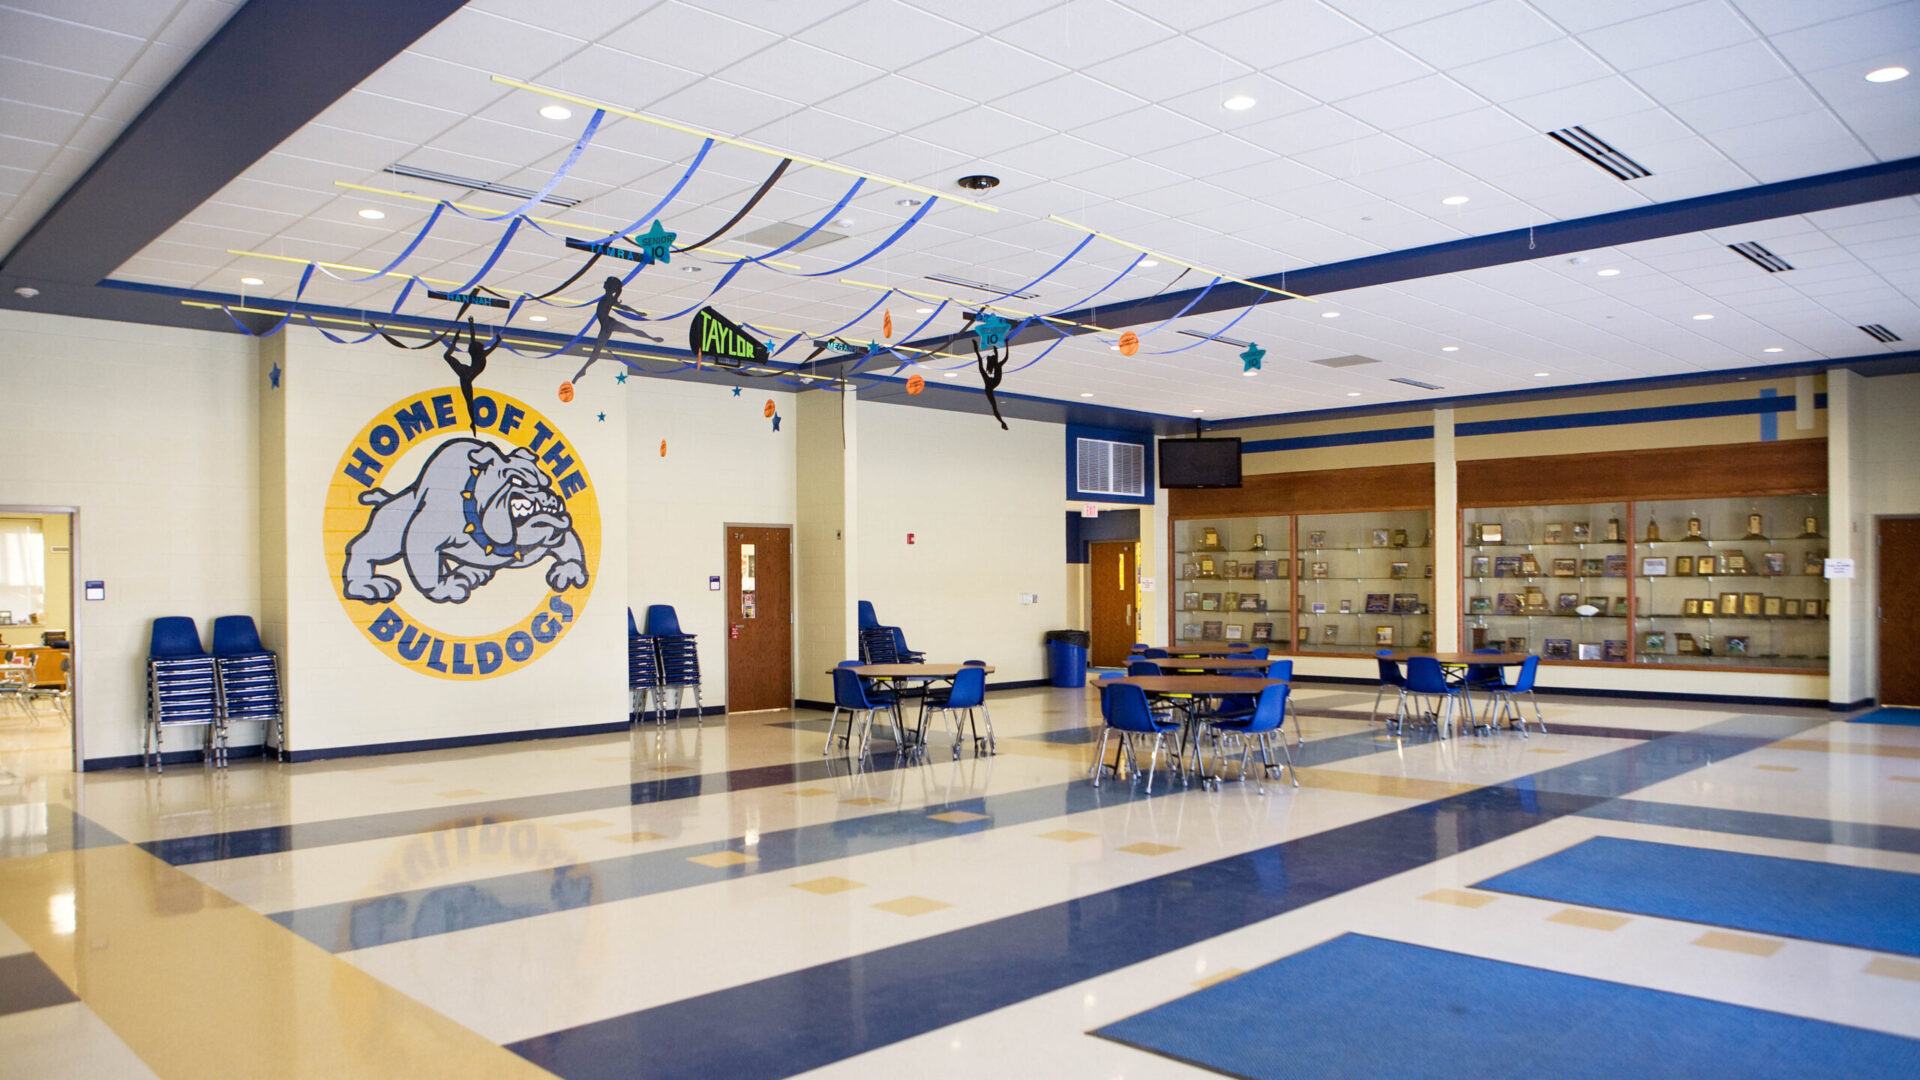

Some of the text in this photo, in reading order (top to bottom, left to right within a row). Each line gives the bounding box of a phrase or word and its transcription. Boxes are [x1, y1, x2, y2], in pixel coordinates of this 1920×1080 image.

[641, 235, 673, 246] SENIOR
[590, 243, 635, 261] TAMRA
[651, 245, 665, 259] 10
[447, 293, 492, 307] HANNAH
[700, 310, 755, 359] TAYLOR
[344, 394, 588, 500] HOME OF THE
[367, 595, 574, 675] BULLDOGS
